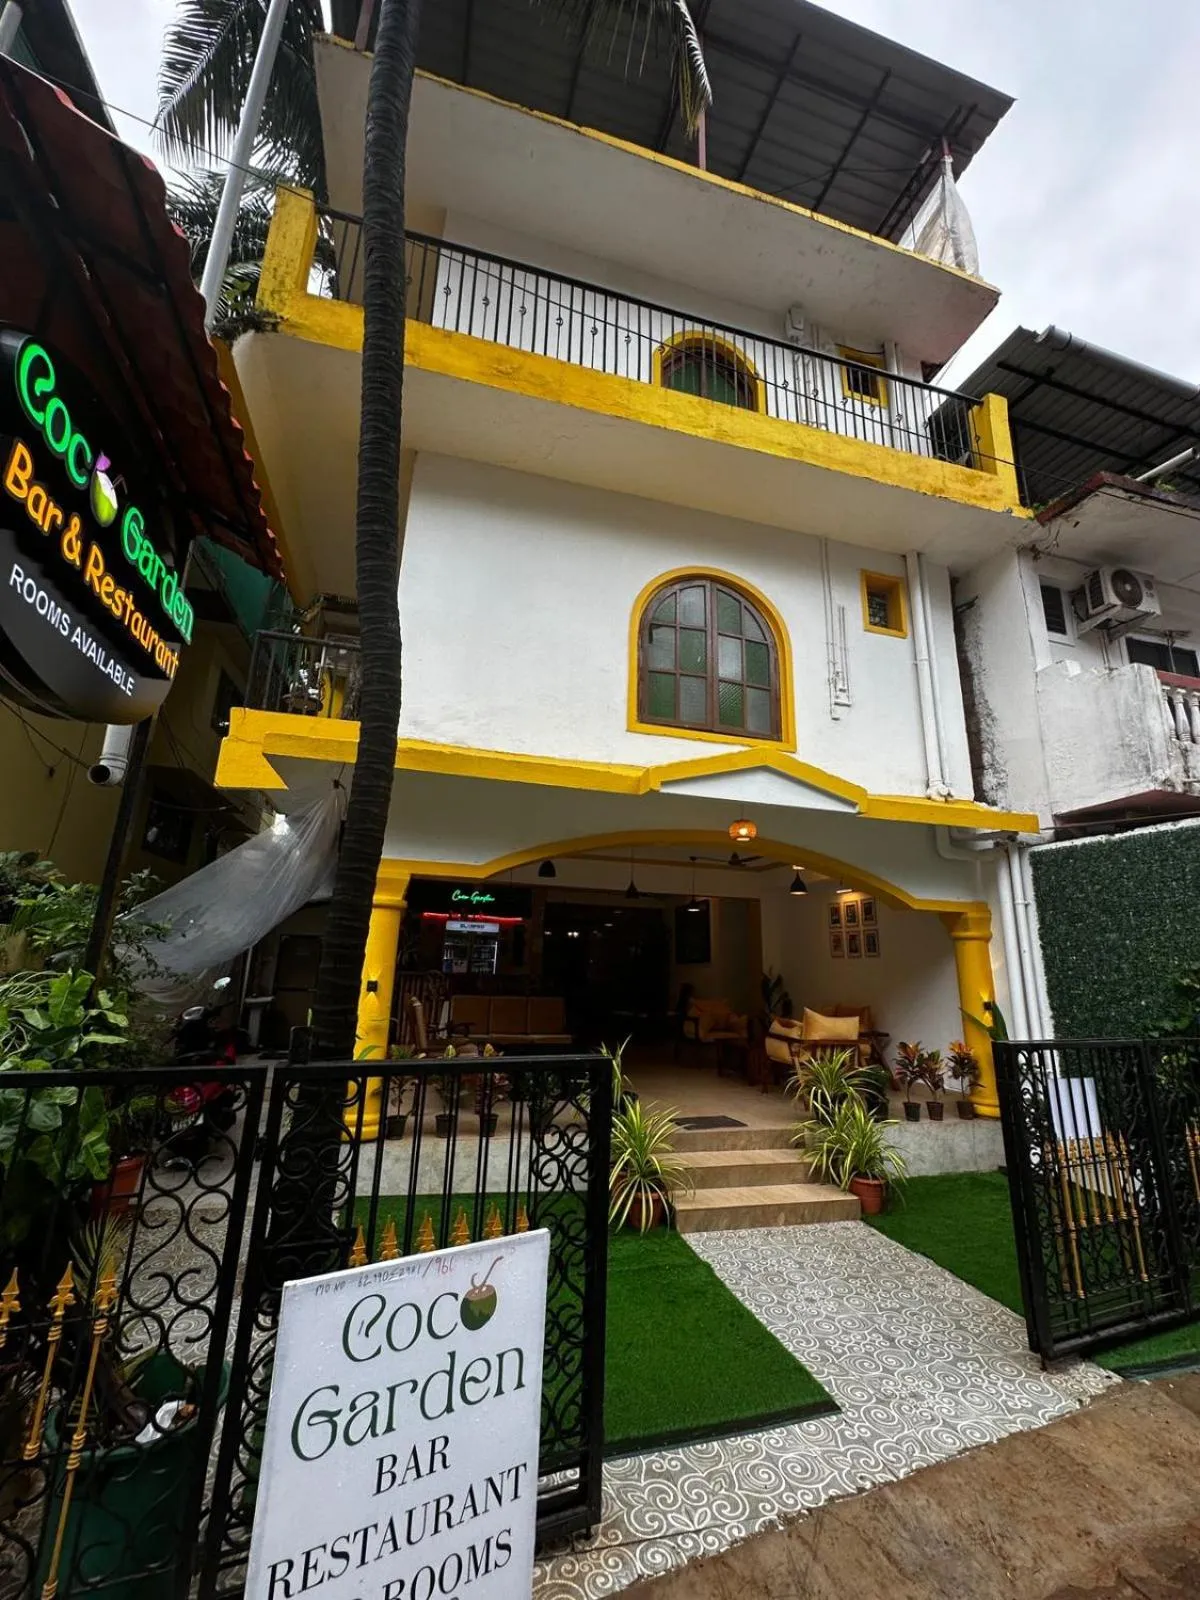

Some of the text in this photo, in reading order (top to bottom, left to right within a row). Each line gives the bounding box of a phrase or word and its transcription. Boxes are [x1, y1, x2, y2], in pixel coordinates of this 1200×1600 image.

[4, 441, 180, 680] Bar & Restaurant
[122, 505, 196, 645] Garden
[9, 563, 135, 697] ROOMS AVAILABLE
[290, 1346, 527, 1463] Garden
[372, 1434, 451, 1497] BAR
[266, 1462, 528, 1600] RESTAURANT
